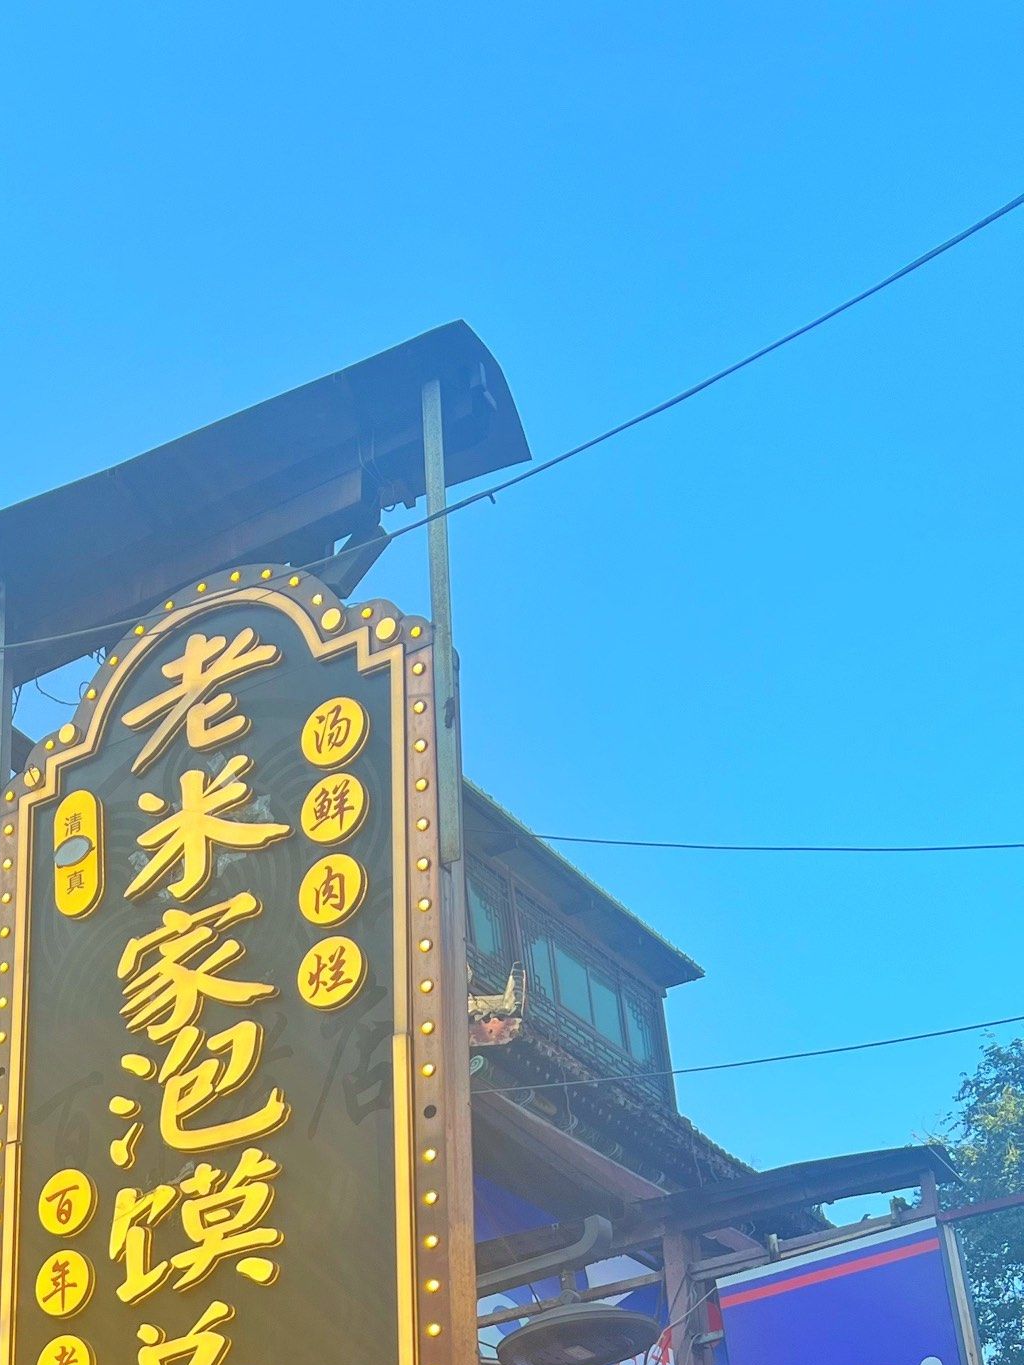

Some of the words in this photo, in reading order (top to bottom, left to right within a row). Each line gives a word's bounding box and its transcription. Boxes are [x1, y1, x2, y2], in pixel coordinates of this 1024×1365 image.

[63, 811, 85, 895] 清真
[308, 707, 356, 998] 汤鲜肉烂
